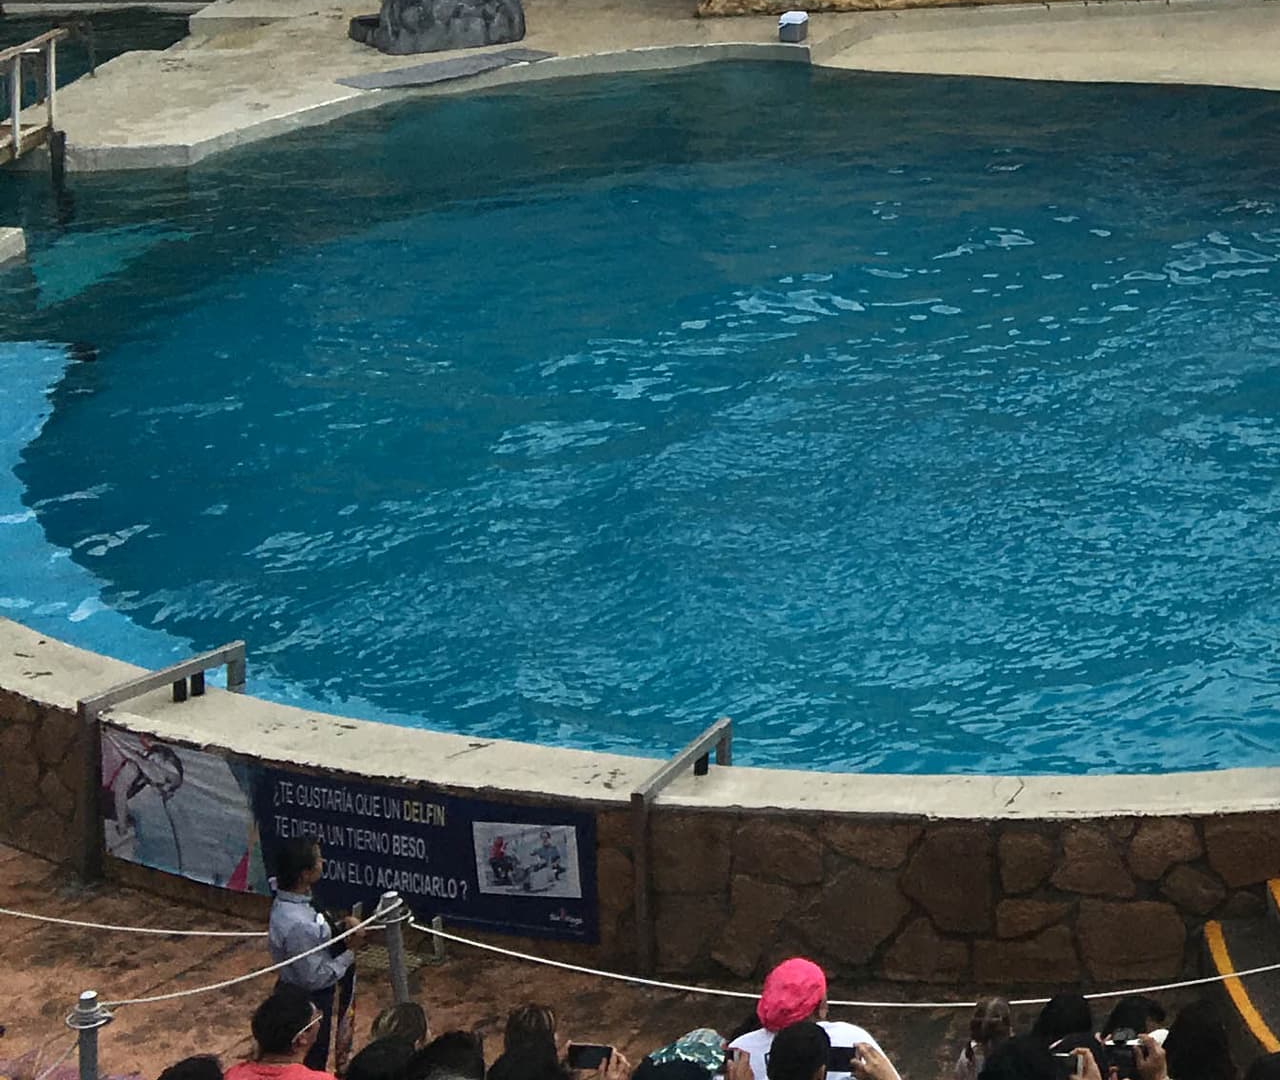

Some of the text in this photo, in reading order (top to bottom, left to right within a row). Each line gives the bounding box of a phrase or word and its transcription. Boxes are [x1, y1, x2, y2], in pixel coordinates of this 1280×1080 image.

[273, 781, 293, 807] ¿TE
[296, 784, 353, 814] GUSTARÍA
[355, 793, 380, 818] QUE
[383, 796, 401, 820] UN
[273, 815, 289, 838] TE
[327, 824, 344, 847] UN
[346, 827, 390, 856] TIERNO
[348, 862, 363, 885] EL
[364, 865, 374, 887] O
[376, 869, 458, 899] ACARICIARLO
